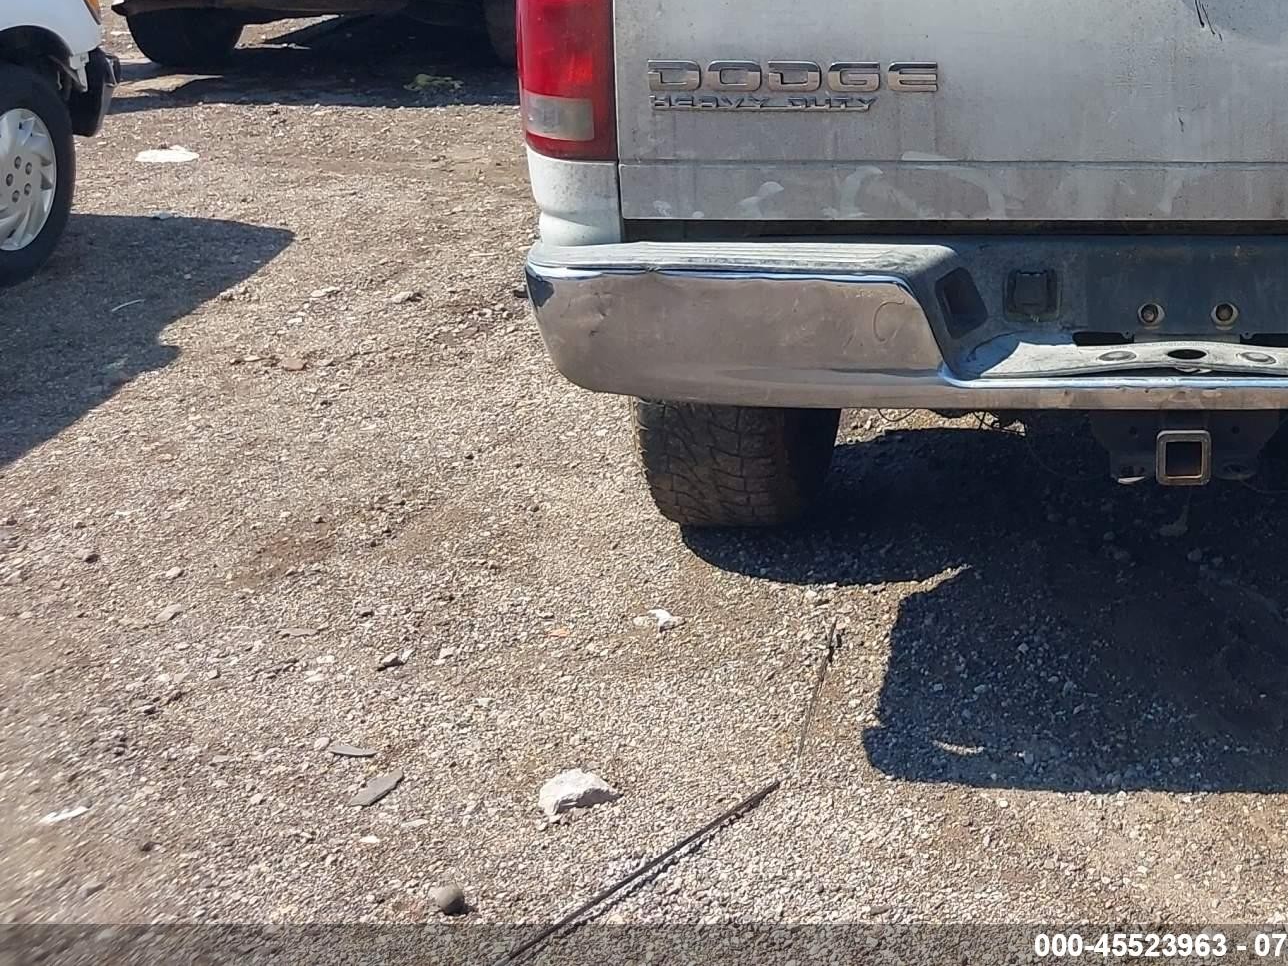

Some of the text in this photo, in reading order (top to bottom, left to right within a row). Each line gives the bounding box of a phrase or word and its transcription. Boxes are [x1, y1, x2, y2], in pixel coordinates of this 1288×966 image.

[647, 59, 939, 92] DODGE
[649, 94, 878, 112] HEAVY DUTY
